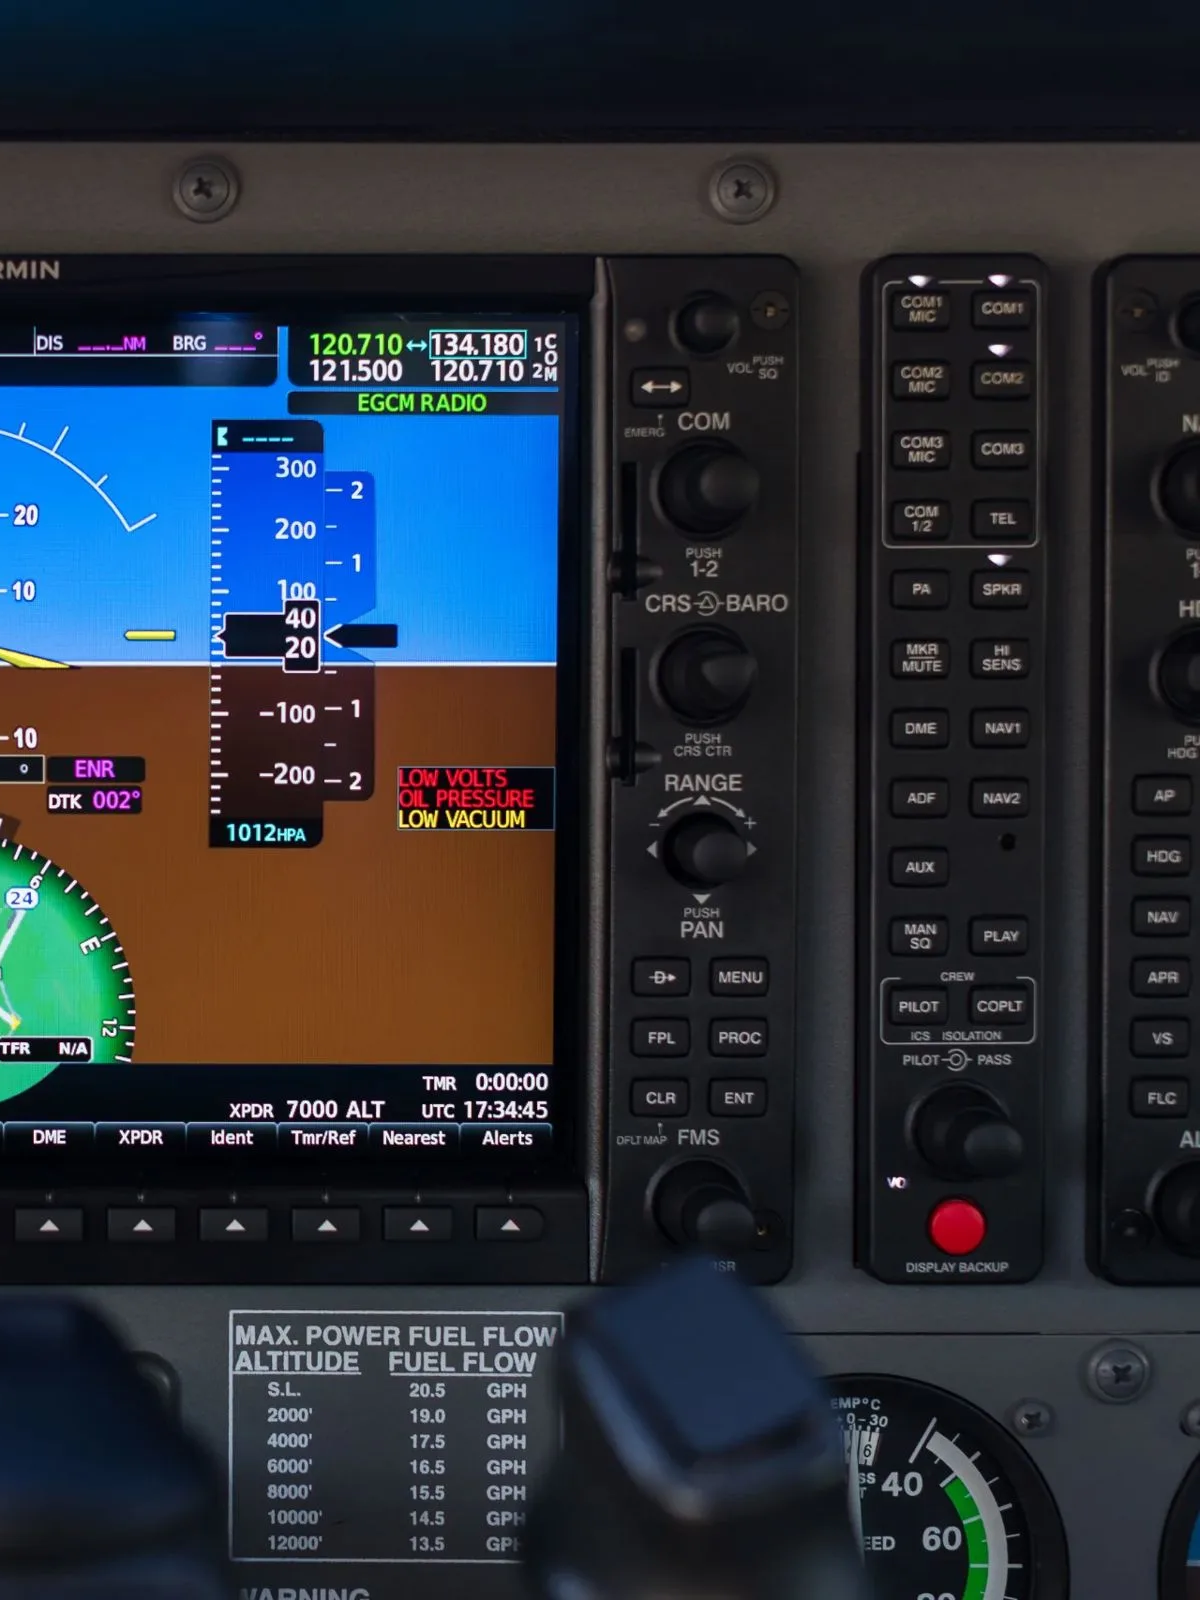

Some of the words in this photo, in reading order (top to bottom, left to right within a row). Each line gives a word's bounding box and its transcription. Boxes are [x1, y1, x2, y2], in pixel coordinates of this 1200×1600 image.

[982, 302, 1023, 314] COM1
[36, 336, 64, 352] DIS
[174, 336, 206, 350] BRG
[310, 333, 403, 356] 120.710
[433, 334, 524, 356] 134.180
[310, 360, 403, 382] 121.500
[432, 360, 524, 382] 120.710
[981, 372, 1023, 384] COM2
[357, 394, 414, 413] EGCM
[421, 394, 487, 413] RADIO
[678, 412, 729, 430] COM
[981, 443, 1024, 455] COM3
[276, 457, 316, 477] 300
[990, 512, 1016, 524] TEL
[275, 518, 316, 539] 200
[913, 583, 930, 594] PA
[983, 584, 1021, 595] SPKR
[645, 594, 692, 614] CRS
[725, 594, 789, 614] BARO
[906, 723, 936, 734] DME
[986, 723, 1020, 733] NAV1
[75, 760, 115, 778] ENR
[399, 770, 439, 787] LOW
[446, 770, 508, 787] VOLTS
[665, 774, 742, 791] RANGE
[49, 794, 82, 809] DTK
[399, 790, 429, 808] OIL
[436, 790, 535, 808] PRESSURE
[908, 793, 936, 804] ADF
[984, 793, 1020, 804] NAV2
[398, 811, 439, 829] LOW
[447, 811, 526, 829] VACUUM
[681, 921, 723, 938] PAN
[984, 931, 1018, 942] PLAY
[719, 971, 762, 983] MENU
[899, 1001, 939, 1012] PILOT
[977, 1001, 1023, 1012] COPLT
[649, 1032, 675, 1044] FPL
[719, 1032, 761, 1044] PROC
[422, 1076, 456, 1090] TMR
[476, 1073, 548, 1091] 0:00:00
[646, 1092, 675, 1104] CLR
[725, 1092, 754, 1104] ENT
[230, 1103, 274, 1119] XPDR
[287, 1101, 338, 1119] 7000
[346, 1101, 385, 1119] ALT
[421, 1103, 455, 1120] UTC
[463, 1101, 549, 1120] 17:34:45
[34, 1130, 66, 1144] DME
[119, 1130, 163, 1144] XPDR
[212, 1129, 253, 1144] Ident
[291, 1130, 356, 1144] Tmr/Ref
[383, 1131, 445, 1145] Nearest
[482, 1130, 532, 1145] Alerts
[678, 1129, 719, 1145] FMS
[906, 1262, 956, 1273] DISPLAY
[959, 1262, 1008, 1272] BACKUP
[236, 1326, 298, 1347] MAX.
[307, 1326, 400, 1345] POWER
[409, 1326, 475, 1346] FUEL
[484, 1327, 556, 1346] FLOW
[235, 1351, 360, 1372] ALTITUDE
[389, 1352, 455, 1373] FUEL
[463, 1352, 537, 1373] FLOW
[268, 1382, 300, 1396] S.L.
[410, 1383, 445, 1398] 20.5
[487, 1383, 526, 1398] GPH
[268, 1408, 312, 1422] 2000'
[411, 1408, 445, 1423] 19.0
[487, 1409, 526, 1423] GPH
[267, 1433, 312, 1448] 4000'
[410, 1434, 445, 1448] 17.5
[487, 1434, 526, 1449] GPH
[922, 1526, 962, 1551] 60
